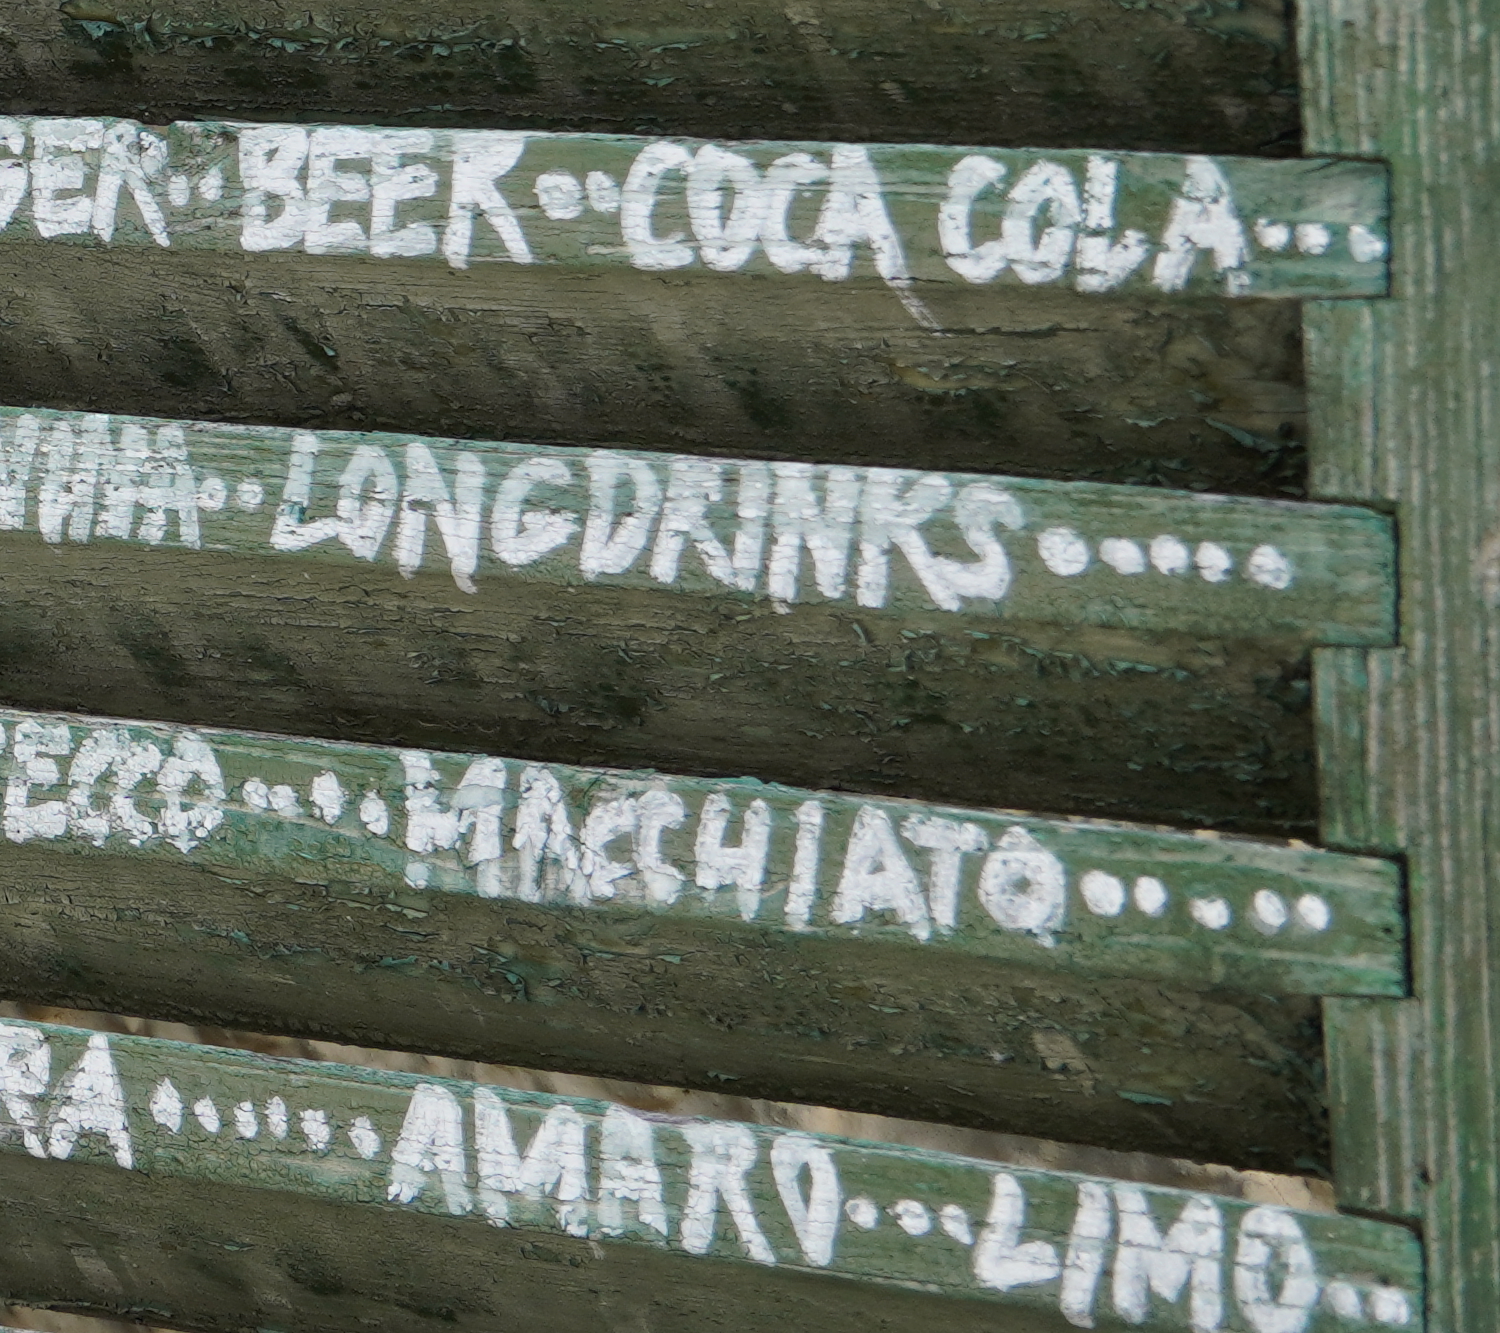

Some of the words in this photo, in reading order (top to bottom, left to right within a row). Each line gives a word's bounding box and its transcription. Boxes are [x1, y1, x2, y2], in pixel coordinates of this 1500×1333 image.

[238, 121, 534, 269] BEER
[621, 143, 908, 291] COCA
[937, 153, 1252, 296] COLA
[269, 429, 1026, 614] LONGDRINKS
[386, 1083, 844, 1269] AMARO
